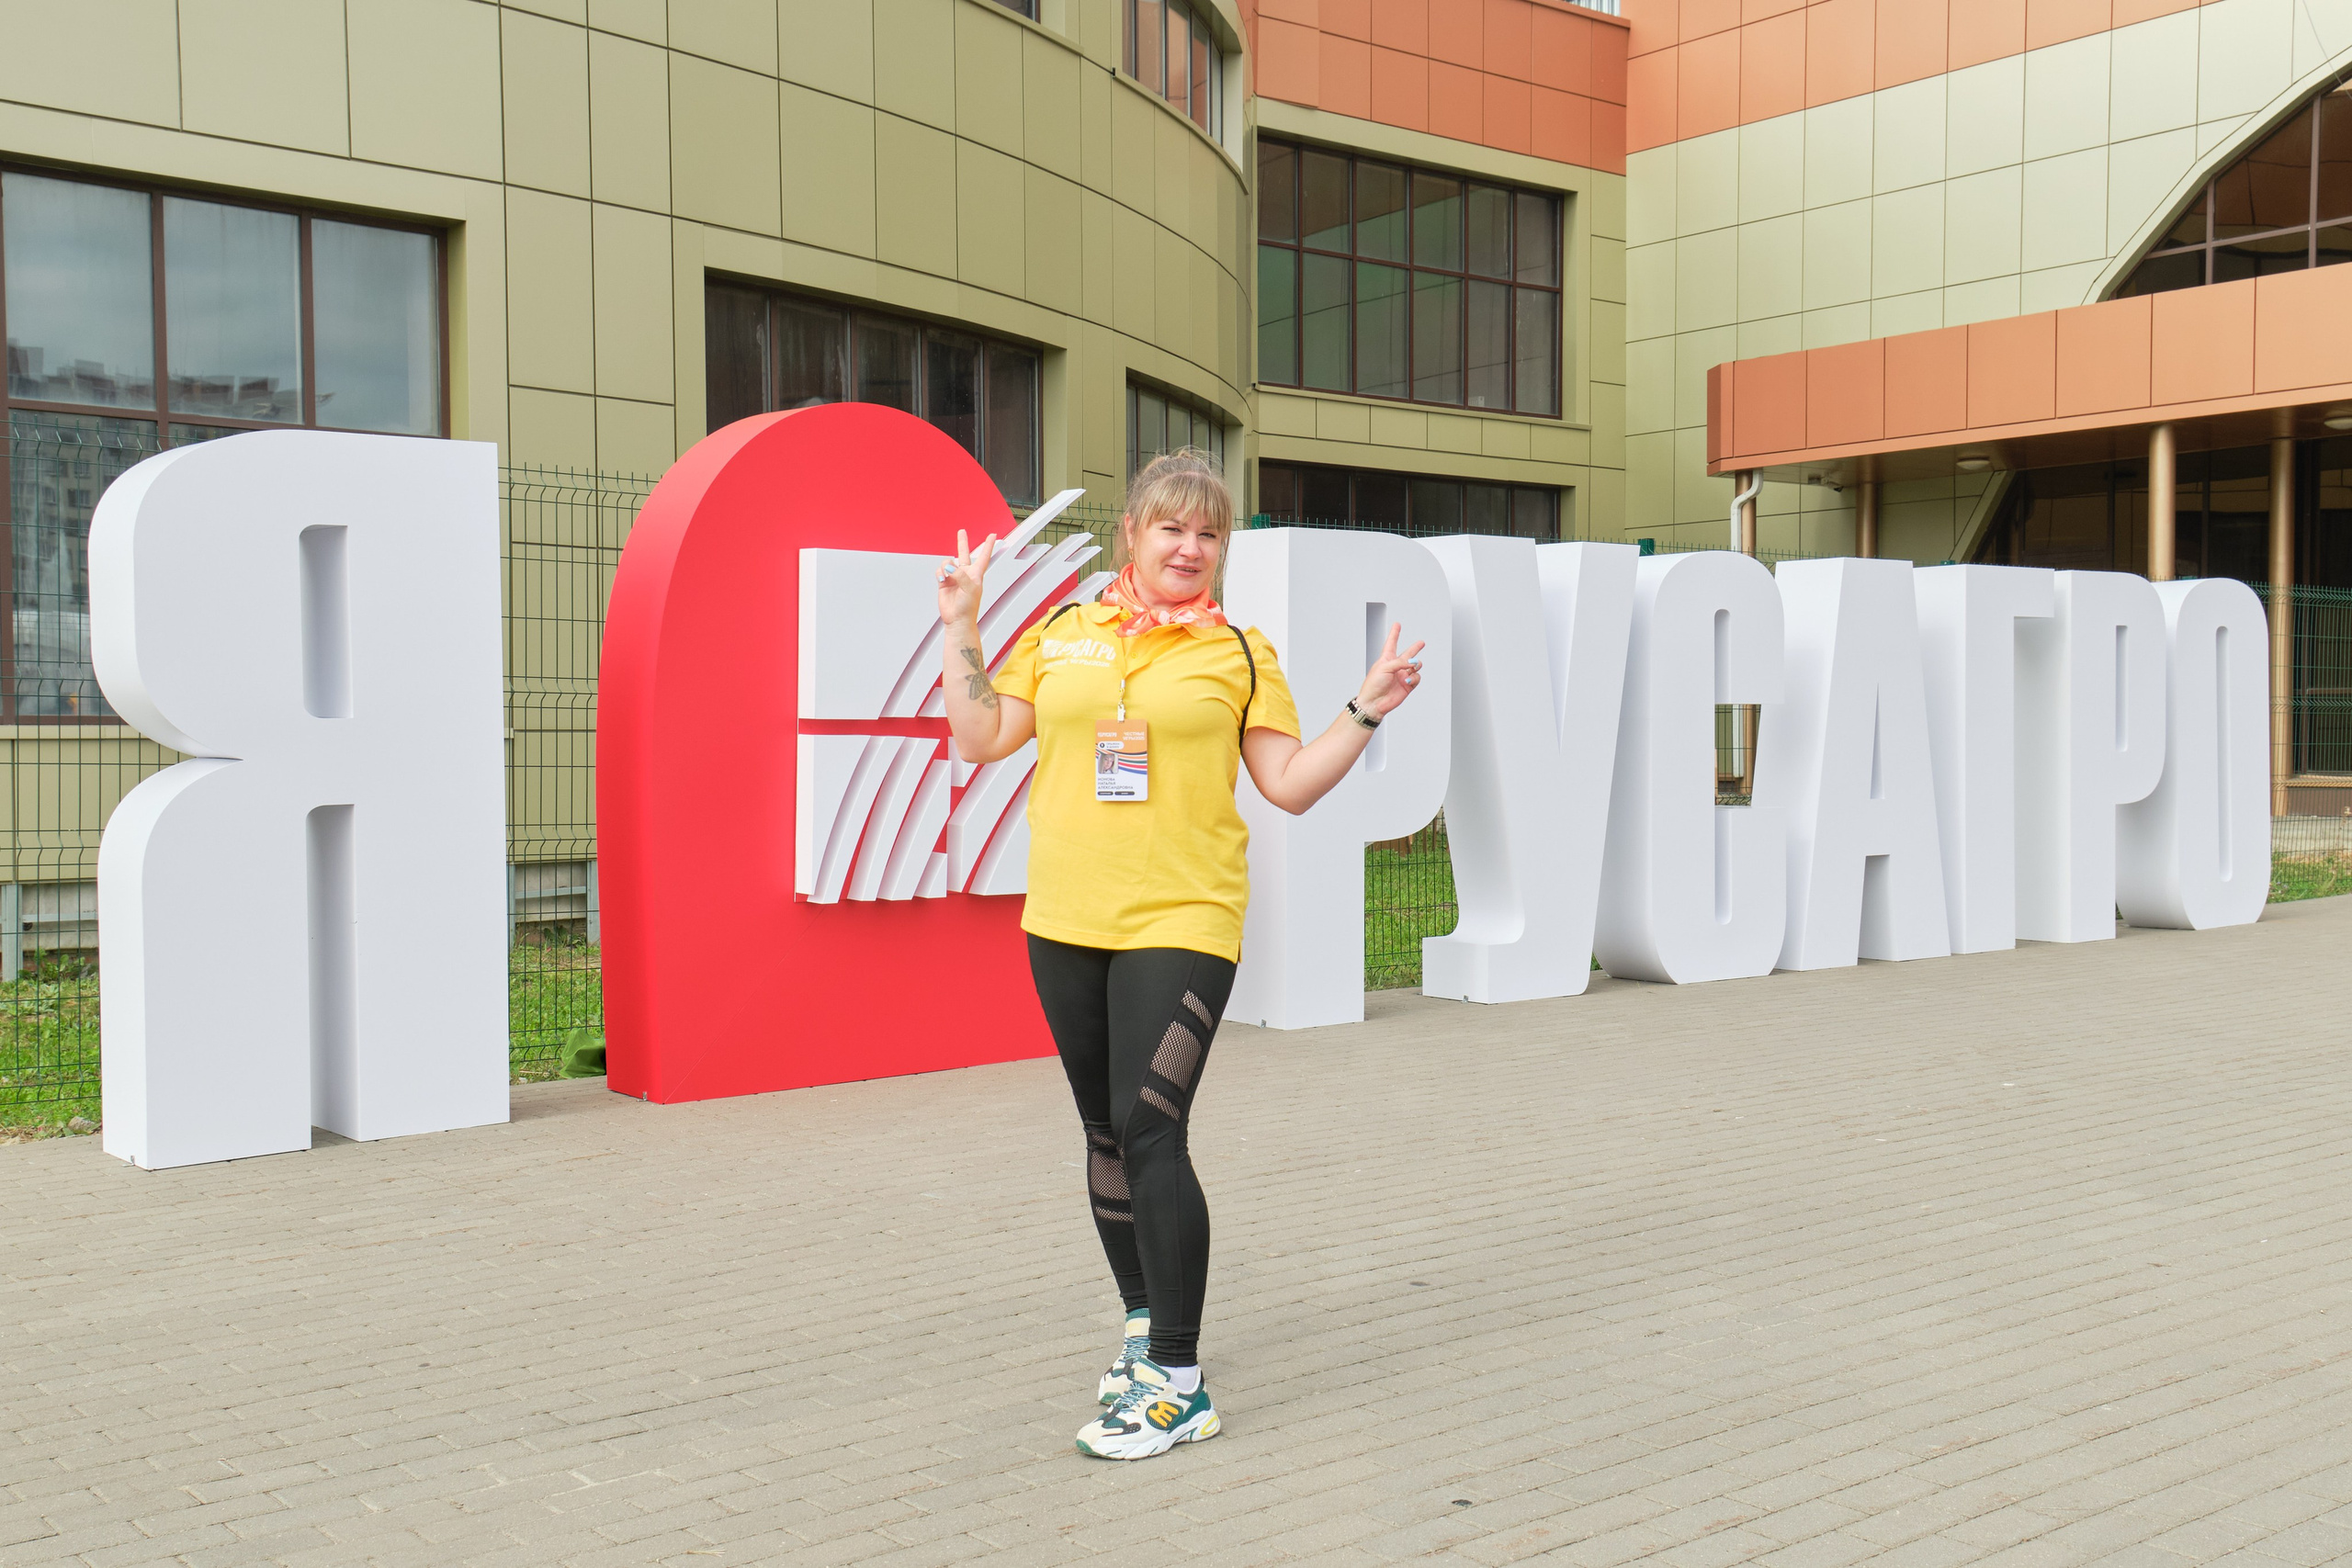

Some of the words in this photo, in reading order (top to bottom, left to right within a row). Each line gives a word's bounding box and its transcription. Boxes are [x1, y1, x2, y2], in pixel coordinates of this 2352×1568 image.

[89, 430, 511, 1170] Я
[1227, 526, 2271, 1031] РУСАГРО
[1057, 638, 1116, 660] РУСАГРО
